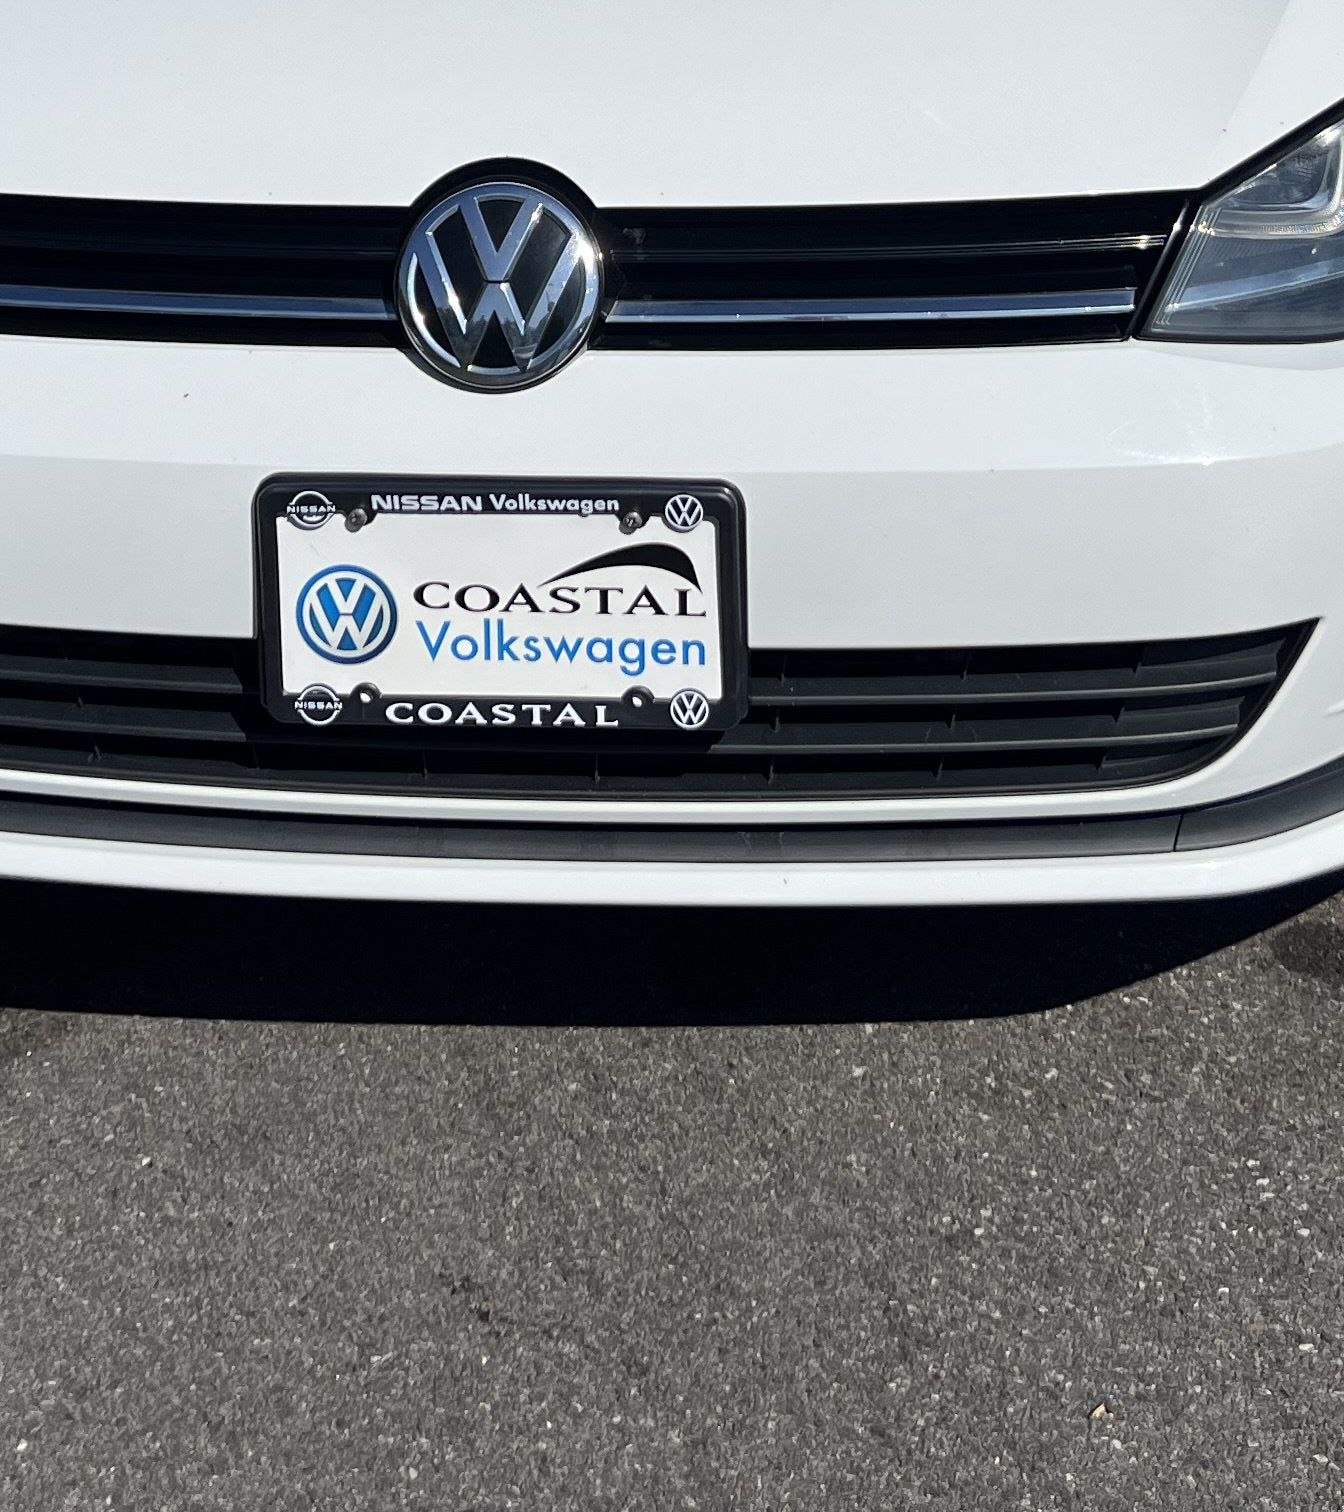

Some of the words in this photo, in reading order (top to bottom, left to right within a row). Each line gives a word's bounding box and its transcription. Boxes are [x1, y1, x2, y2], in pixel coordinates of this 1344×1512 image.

[286, 505, 336, 513] NISSAN
[371, 493, 482, 512] NISSAN
[489, 494, 620, 517] Volkswagen
[413, 581, 707, 618] COASTAL
[416, 619, 706, 677] Volkswagen
[294, 701, 343, 710] NISSAN
[385, 699, 619, 728] COASTAL
